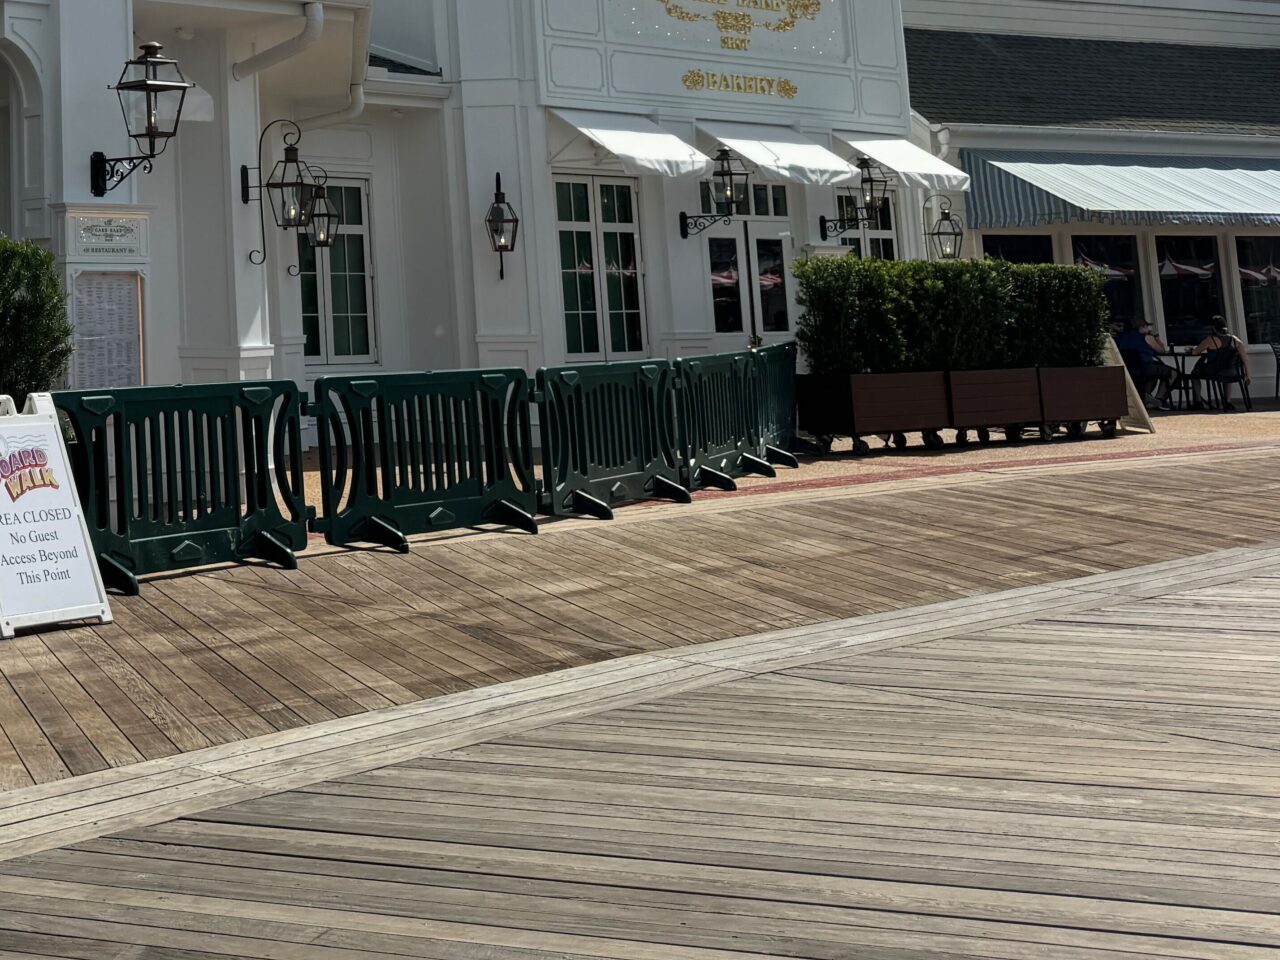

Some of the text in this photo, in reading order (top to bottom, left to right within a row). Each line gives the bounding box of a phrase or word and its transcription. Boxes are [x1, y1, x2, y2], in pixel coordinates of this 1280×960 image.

[720, 36, 751, 51] SHOP
[706, 72, 775, 96] BAKERY
[5, 467, 60, 503] WALK
[24, 508, 72, 523] CLOSED
[10, 529, 59, 544] No Guest
[0, 546, 78, 567] Access Beyond
[16, 567, 71, 585] This Point
